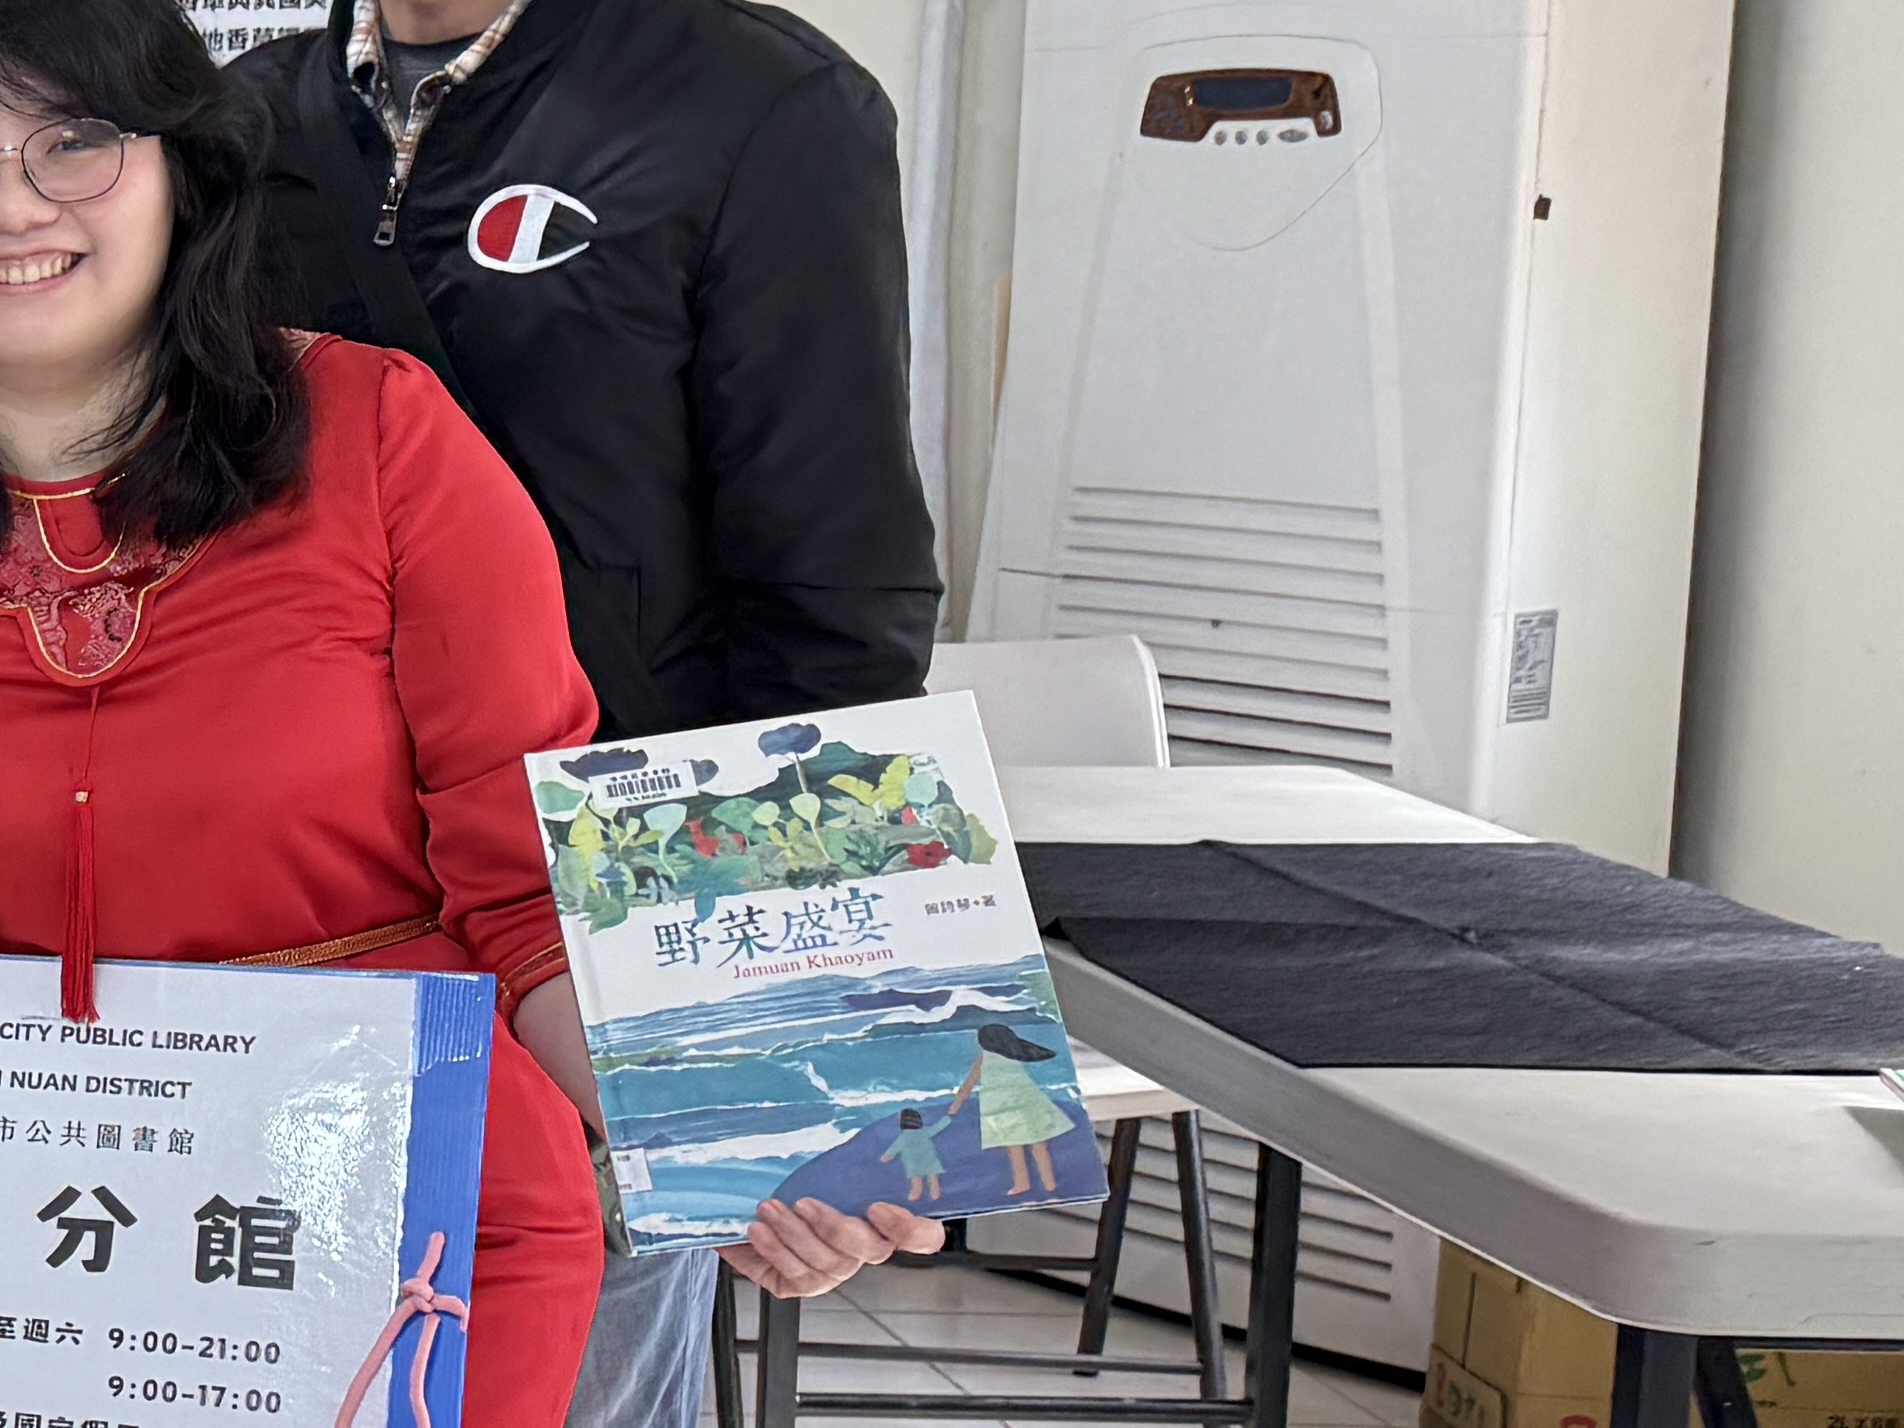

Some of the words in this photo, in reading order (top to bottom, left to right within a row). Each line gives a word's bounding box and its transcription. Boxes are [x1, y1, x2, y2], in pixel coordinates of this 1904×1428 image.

[654, 887, 893, 968] 野菜盛宴
[733, 961, 800, 979] Jamuan
[806, 948, 894, 972] Khaoyam
[60, 1023, 145, 1050] PUBLIC
[150, 1028, 256, 1055] LIBRARY
[7, 1069, 80, 1094] NUAN
[84, 1073, 193, 1100] DISTRICT
[107, 1325, 281, 1365] 9:00-21:00
[107, 1374, 281, 1414] 9:00-17:00
